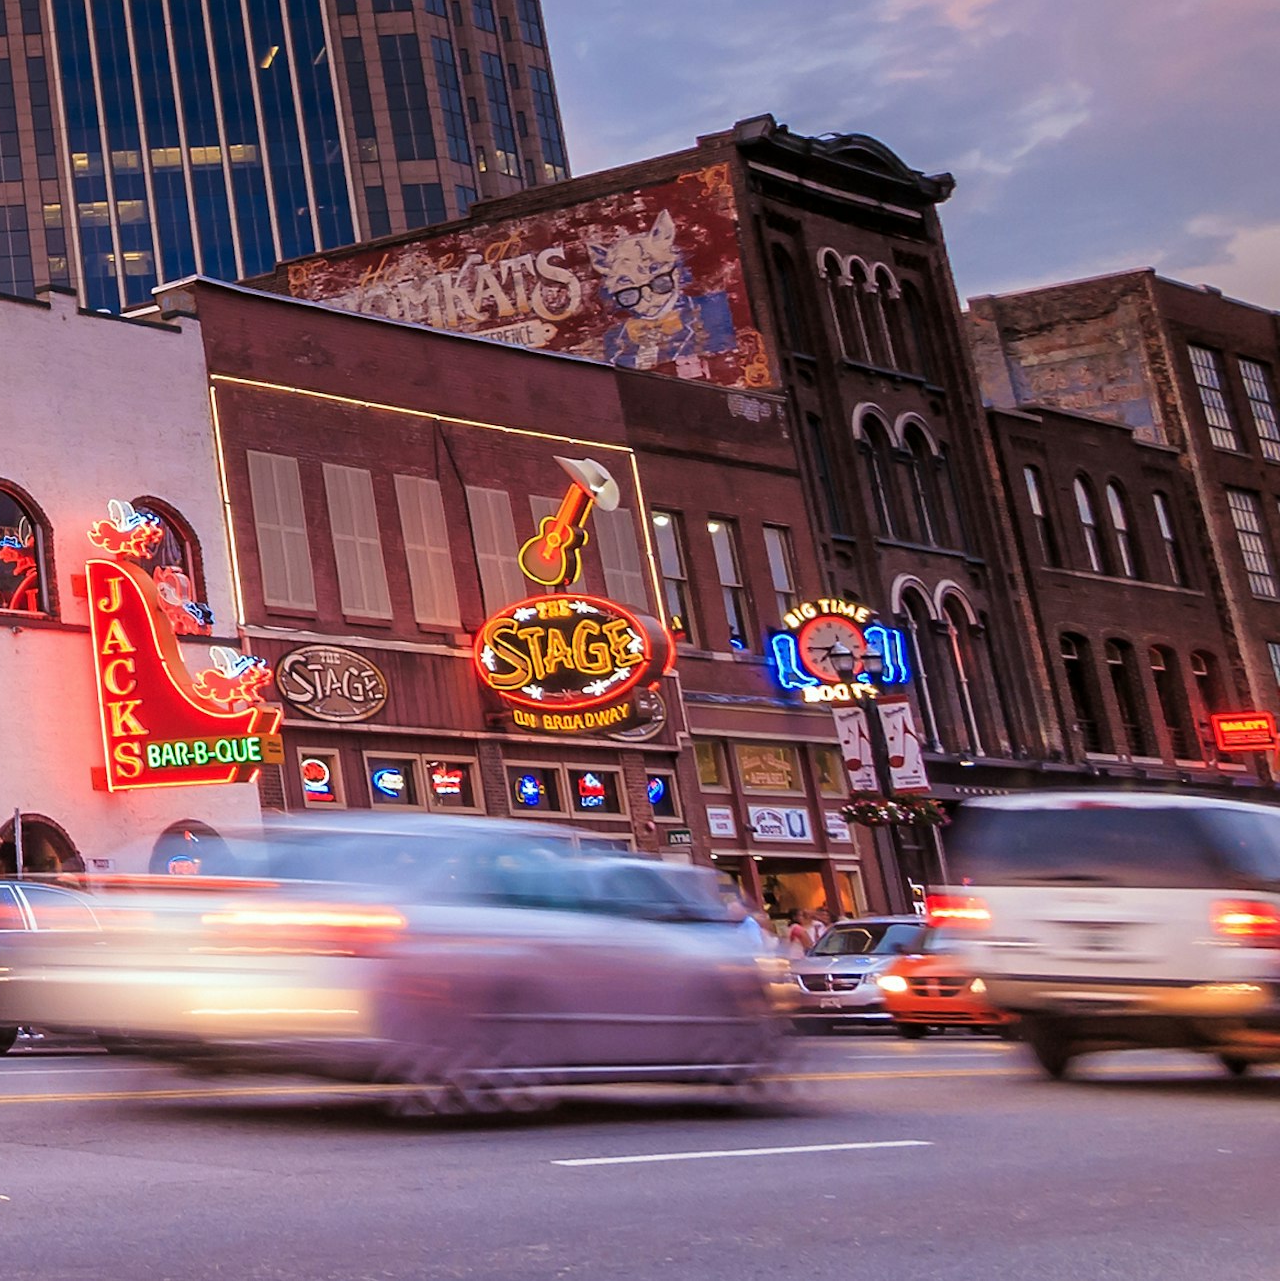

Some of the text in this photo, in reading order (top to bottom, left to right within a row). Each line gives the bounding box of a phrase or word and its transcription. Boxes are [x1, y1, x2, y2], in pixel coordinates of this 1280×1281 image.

[535, 599, 573, 619] THE
[783, 598, 871, 629] BIG TIME
[319, 652, 341, 664] THE
[484, 617, 644, 690] STAGE
[98, 576, 149, 779] JACKS
[284, 654, 384, 703] STAGE
[514, 704, 630, 730] ON BROADWAY
[147, 736, 262, 768] BAR-B-QUE
[669, 833, 691, 844] ATM
